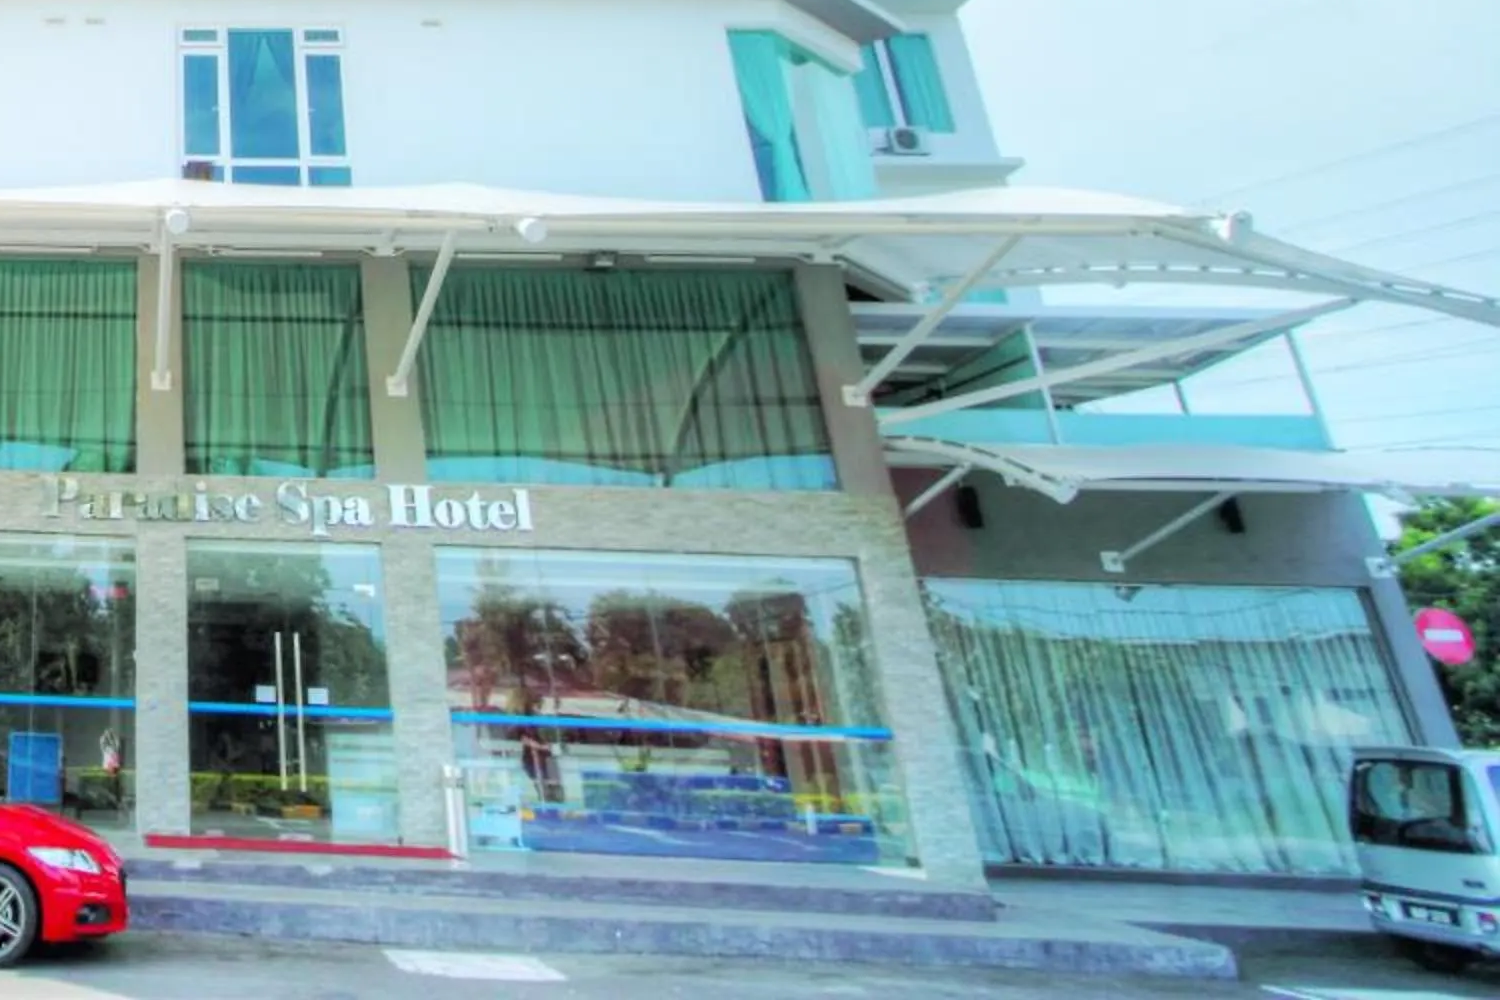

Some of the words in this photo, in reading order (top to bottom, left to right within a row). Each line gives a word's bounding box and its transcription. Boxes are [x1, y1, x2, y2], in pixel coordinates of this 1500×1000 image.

[41, 475, 261, 524] Paradise
[276, 480, 376, 537] Spa
[386, 483, 535, 532] Hotel
